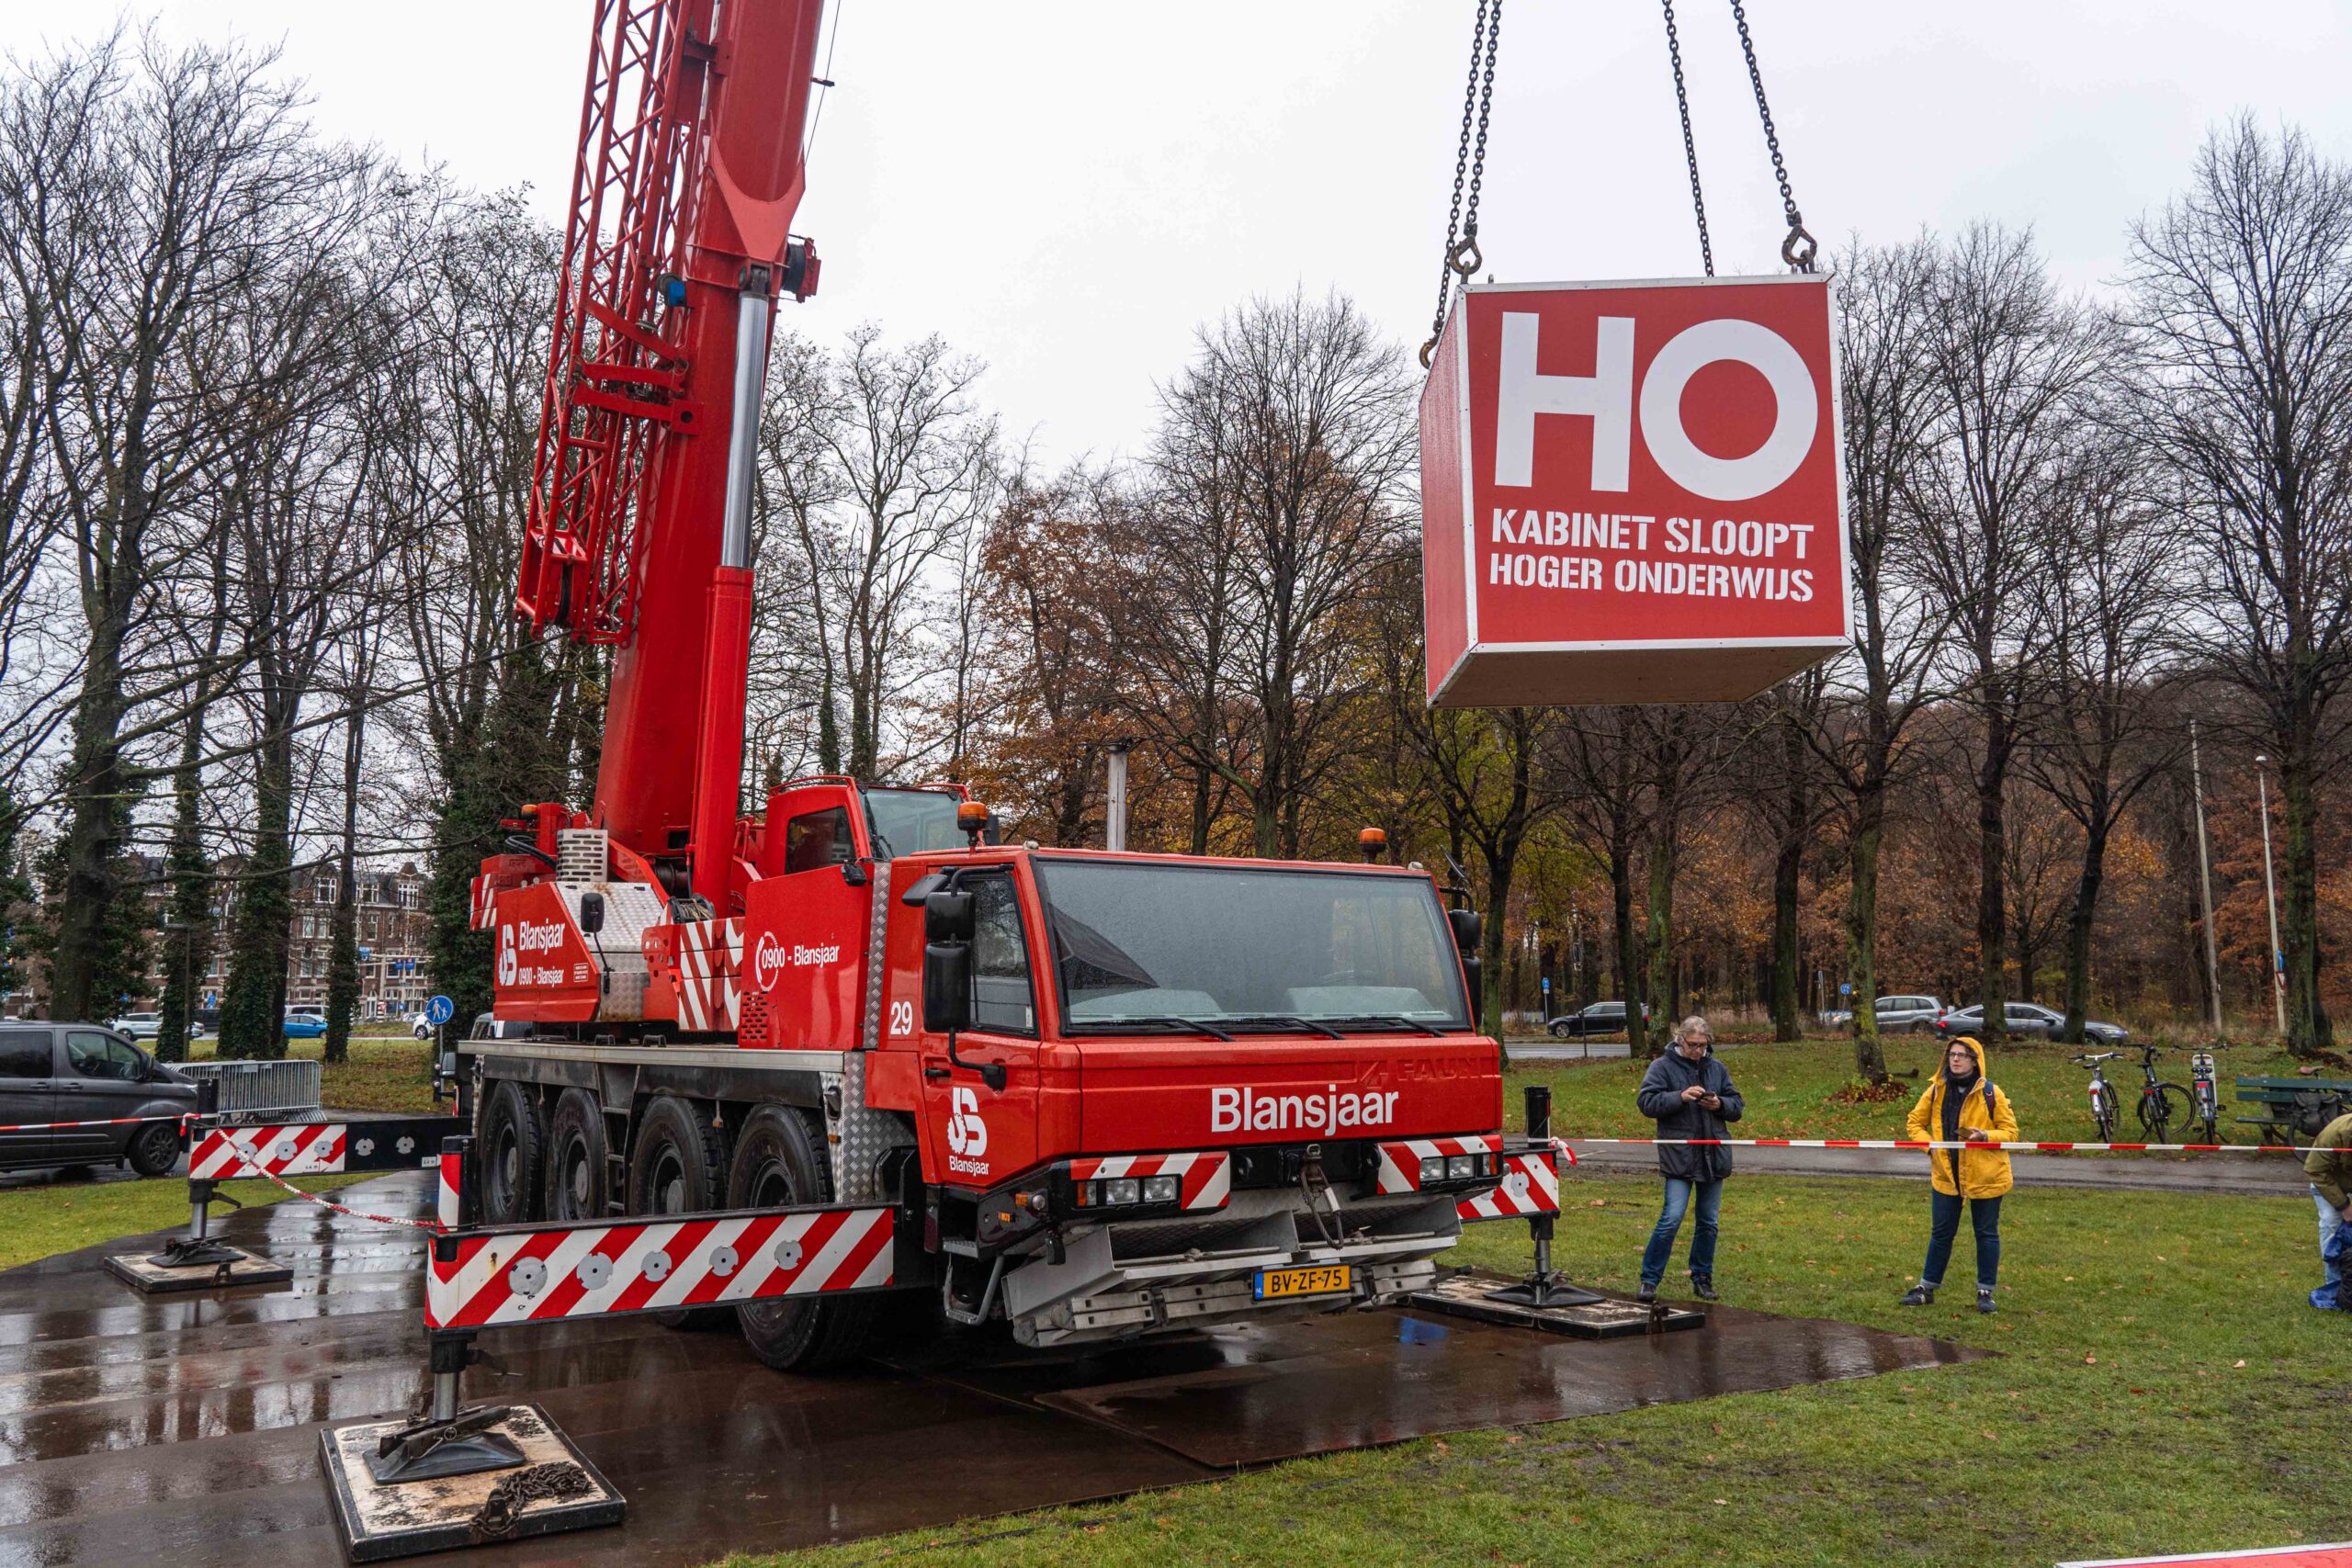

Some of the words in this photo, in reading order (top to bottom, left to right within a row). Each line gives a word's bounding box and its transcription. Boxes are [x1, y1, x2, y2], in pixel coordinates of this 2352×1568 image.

[1495, 311, 1818, 502] HO
[1492, 508, 1656, 550] KABINET
[1664, 517, 1815, 558] SLOOPT
[1489, 553, 1602, 590] HOGER
[1614, 559, 1815, 602] ONDERWIJS
[519, 918, 565, 955] Blansjaar
[762, 946, 786, 969] 0900
[794, 942, 840, 968] Blansjaar
[518, 967, 533, 985] 0900
[537, 966, 564, 987] Blansjaar
[890, 1001, 913, 1035] 29
[1211, 1084, 1399, 1136] Blansjaar
[948, 1155, 989, 1177] Blansjaar
[1272, 1269, 1342, 1293] BV-ZF-75
